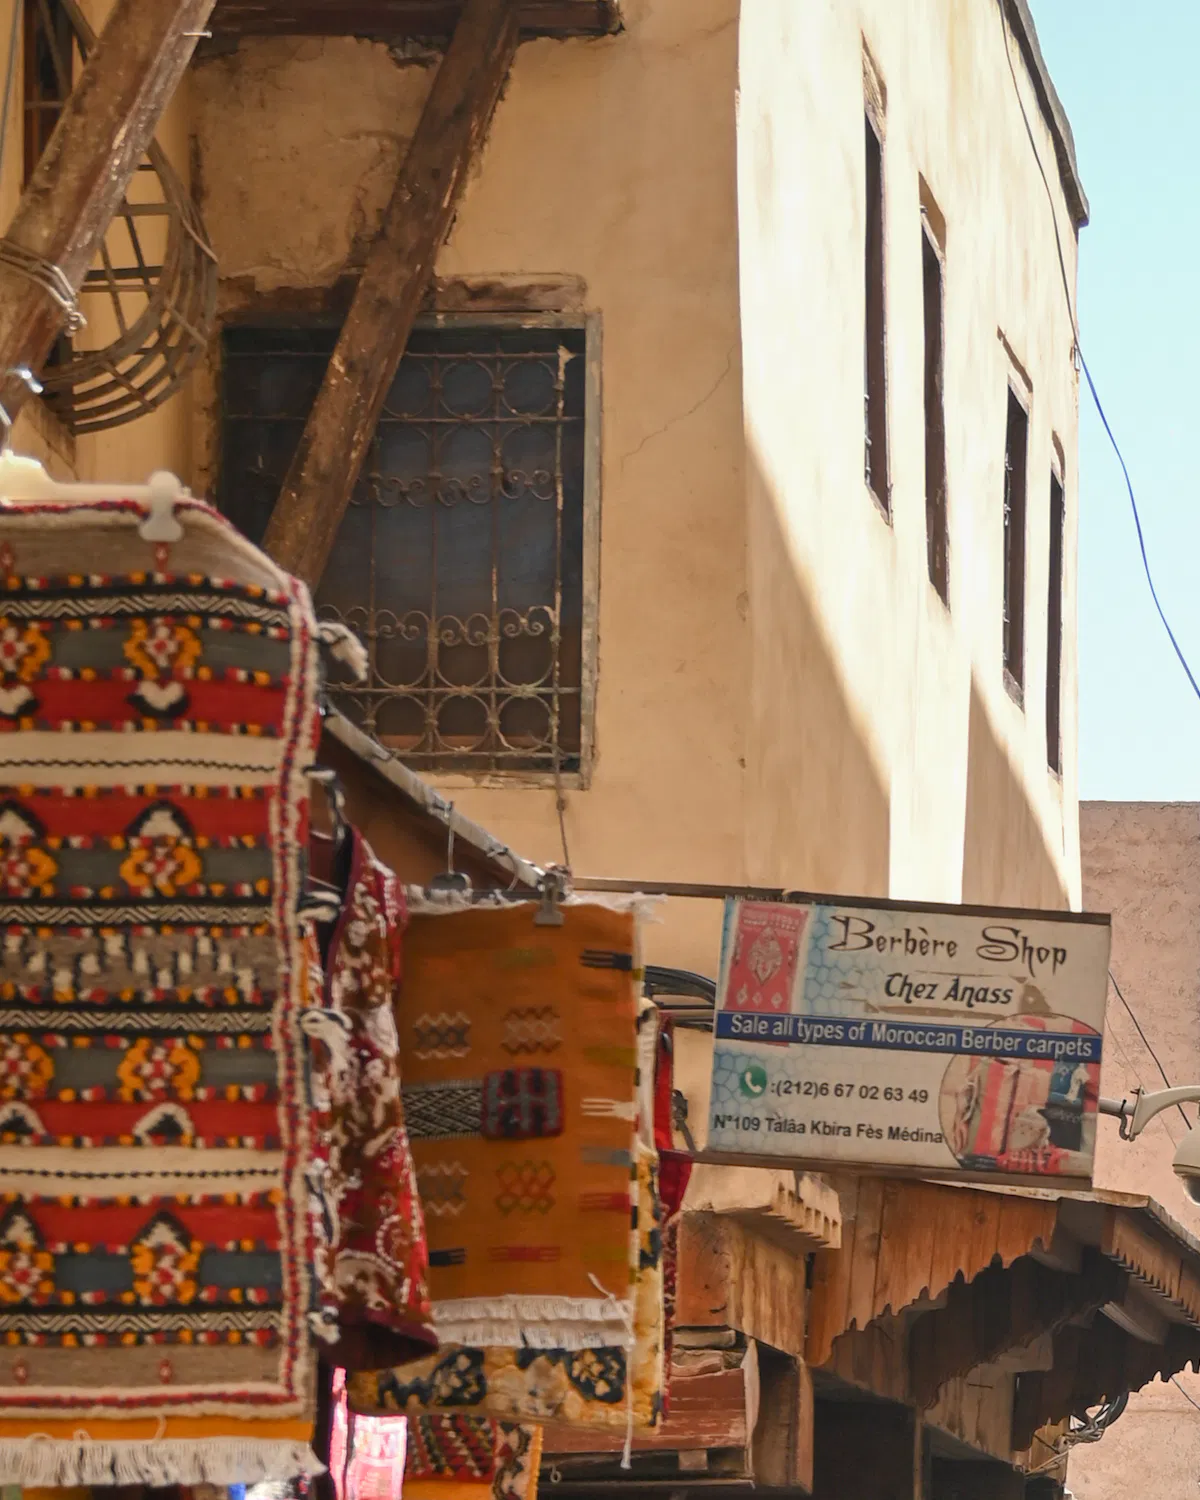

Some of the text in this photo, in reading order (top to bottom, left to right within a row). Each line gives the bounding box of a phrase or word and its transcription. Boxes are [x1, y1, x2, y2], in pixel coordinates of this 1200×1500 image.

[827, 915, 1068, 978] Berbère Shop
[884, 972, 1015, 1008] Chez Anass
[731, 1014, 1093, 1058] Sale all types of Moroccan Berber carpets
[834, 1083, 854, 1098] 67
[859, 1084, 878, 1100] 02
[884, 1088, 903, 1102] 63
[908, 1089, 929, 1104] 49
[811, 1120, 851, 1137] Kbira
[856, 1124, 883, 1140] Fès
[888, 1126, 943, 1144] Médina
